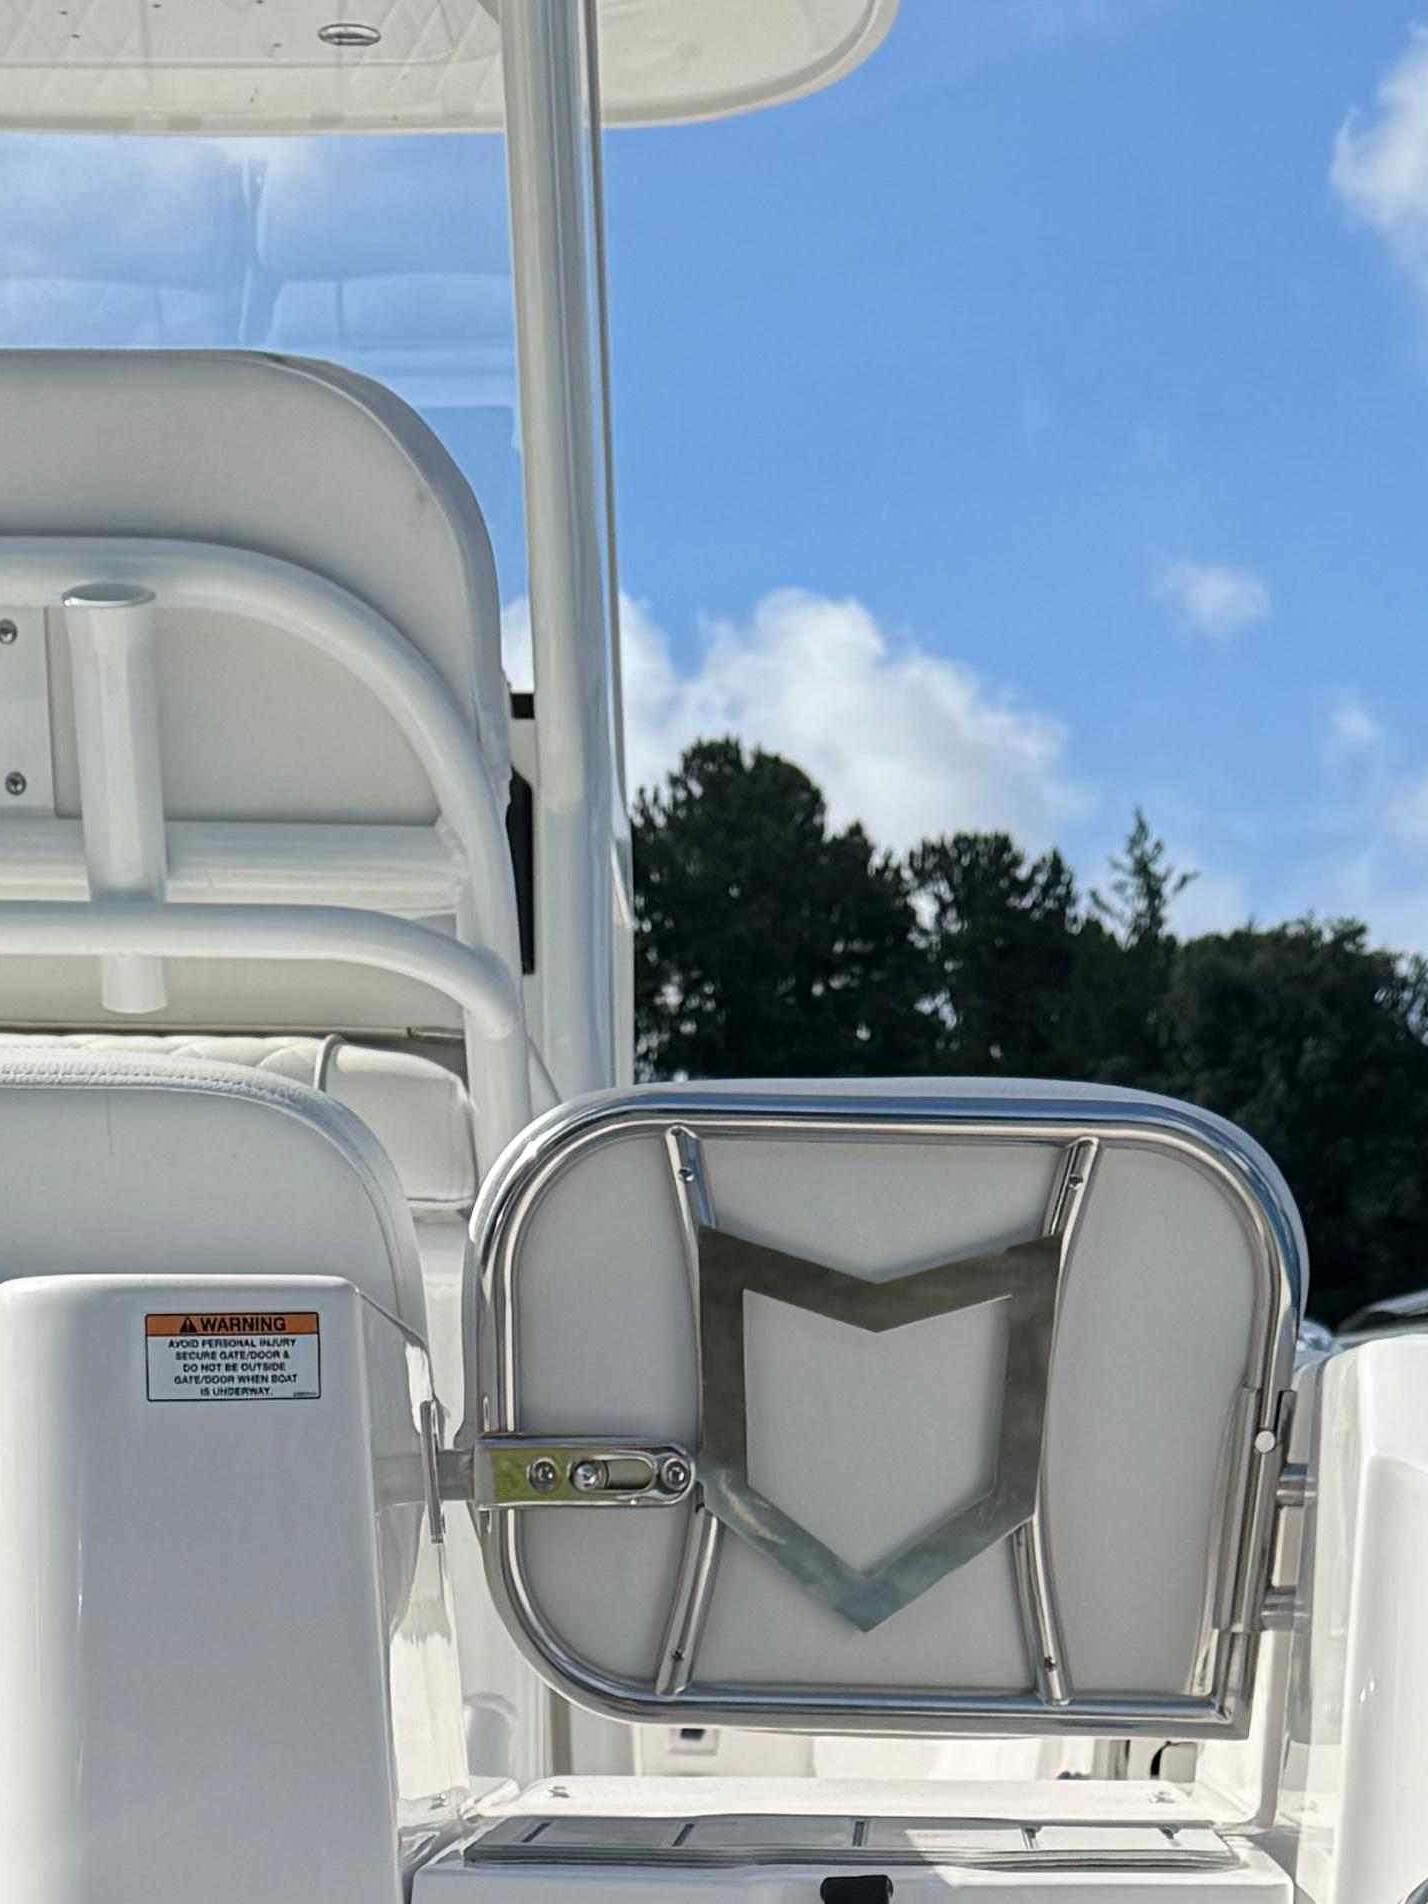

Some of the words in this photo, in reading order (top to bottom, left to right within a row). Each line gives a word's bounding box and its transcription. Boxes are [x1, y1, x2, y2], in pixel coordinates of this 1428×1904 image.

[200, 1317, 287, 1332] WARNING
[168, 1339, 199, 1349] AVOID
[201, 1339, 256, 1348] PERSONAL
[259, 1338, 297, 1348] INJURY
[175, 1351, 217, 1360] SECURE
[219, 1350, 281, 1360] GATE/DOOR
[183, 1363, 198, 1372] DO
[201, 1363, 222, 1372] NOT
[225, 1363, 237, 1372] BE
[241, 1362, 286, 1371] OUTSIDE
[174, 1375, 235, 1384] GATE/DOOR
[238, 1374, 269, 1384] WHEN
[272, 1374, 298, 1383] BOAT
[200, 1388, 210, 1396] IS
